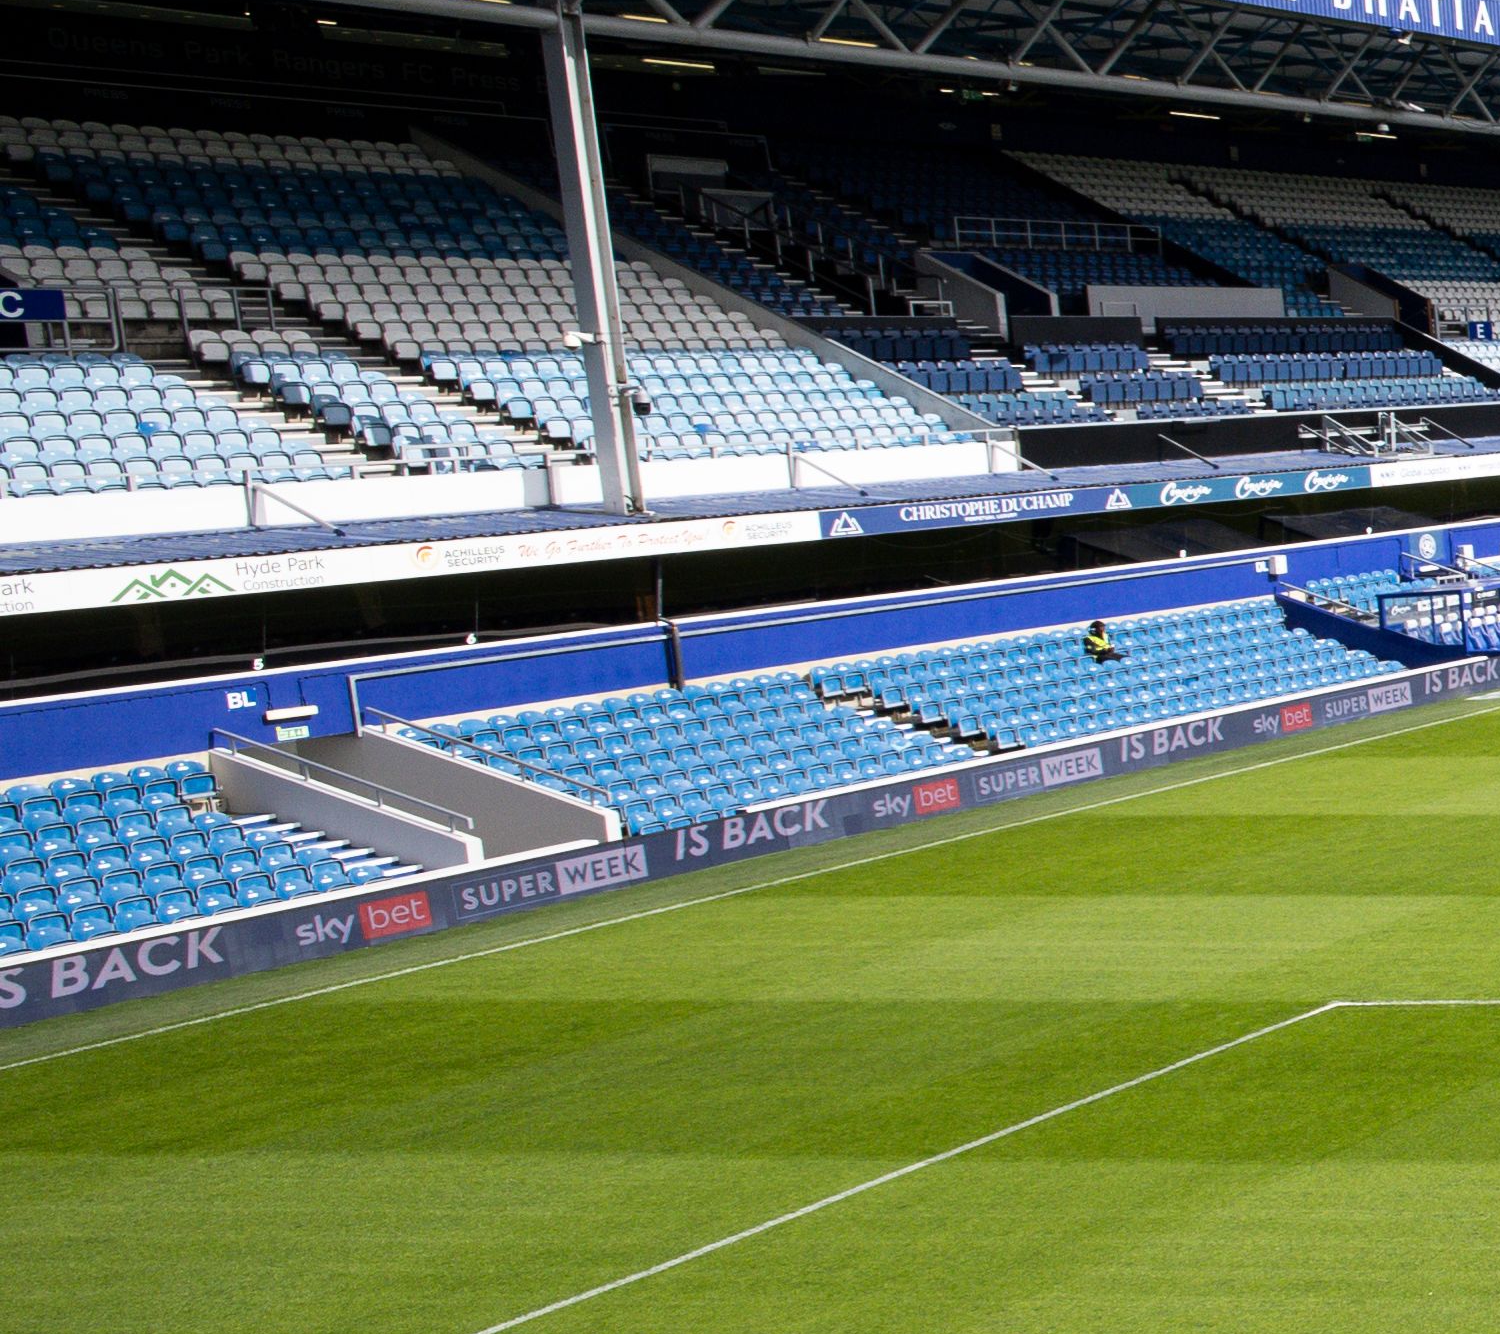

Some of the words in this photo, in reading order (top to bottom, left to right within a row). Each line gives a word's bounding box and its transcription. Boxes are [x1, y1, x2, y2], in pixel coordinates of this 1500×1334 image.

[1475, 323, 1485, 339] E
[900, 498, 1001, 522] CHRISTOPHE
[1001, 492, 1074, 512] DUCHAMP
[744, 520, 793, 533] ACHILLEUS
[746, 528, 790, 541] SECURITY
[444, 545, 505, 560] ACHILLEUS
[447, 555, 500, 568] SECURITY
[235, 560, 282, 578] Hyde
[287, 556, 326, 572] Park
[243, 574, 325, 592] Construction
[466, 633, 478, 645] 6
[253, 659, 264, 670] 5
[227, 691, 256, 709] BL
[1254, 713, 1280, 734] sky
[1284, 706, 1311, 726] bet
[1325, 697, 1367, 718] SUPER
[1372, 686, 1410, 706] WEEK
[1425, 671, 1443, 695] IS
[1448, 660, 1499, 690] BACK
[873, 791, 911, 818] sky
[919, 783, 957, 807] bet
[979, 769, 1041, 796] SUPER
[1046, 756, 1099, 779] WEEK
[1120, 736, 1146, 763] IS
[1154, 717, 1225, 756] BACK
[295, 914, 354, 946] sky
[367, 899, 426, 929] bet
[461, 871, 556, 912] SUPER
[563, 852, 644, 885] WEEK
[675, 824, 710, 861] IS
[723, 801, 830, 850] BACK
[52, 926, 225, 999] BACK
